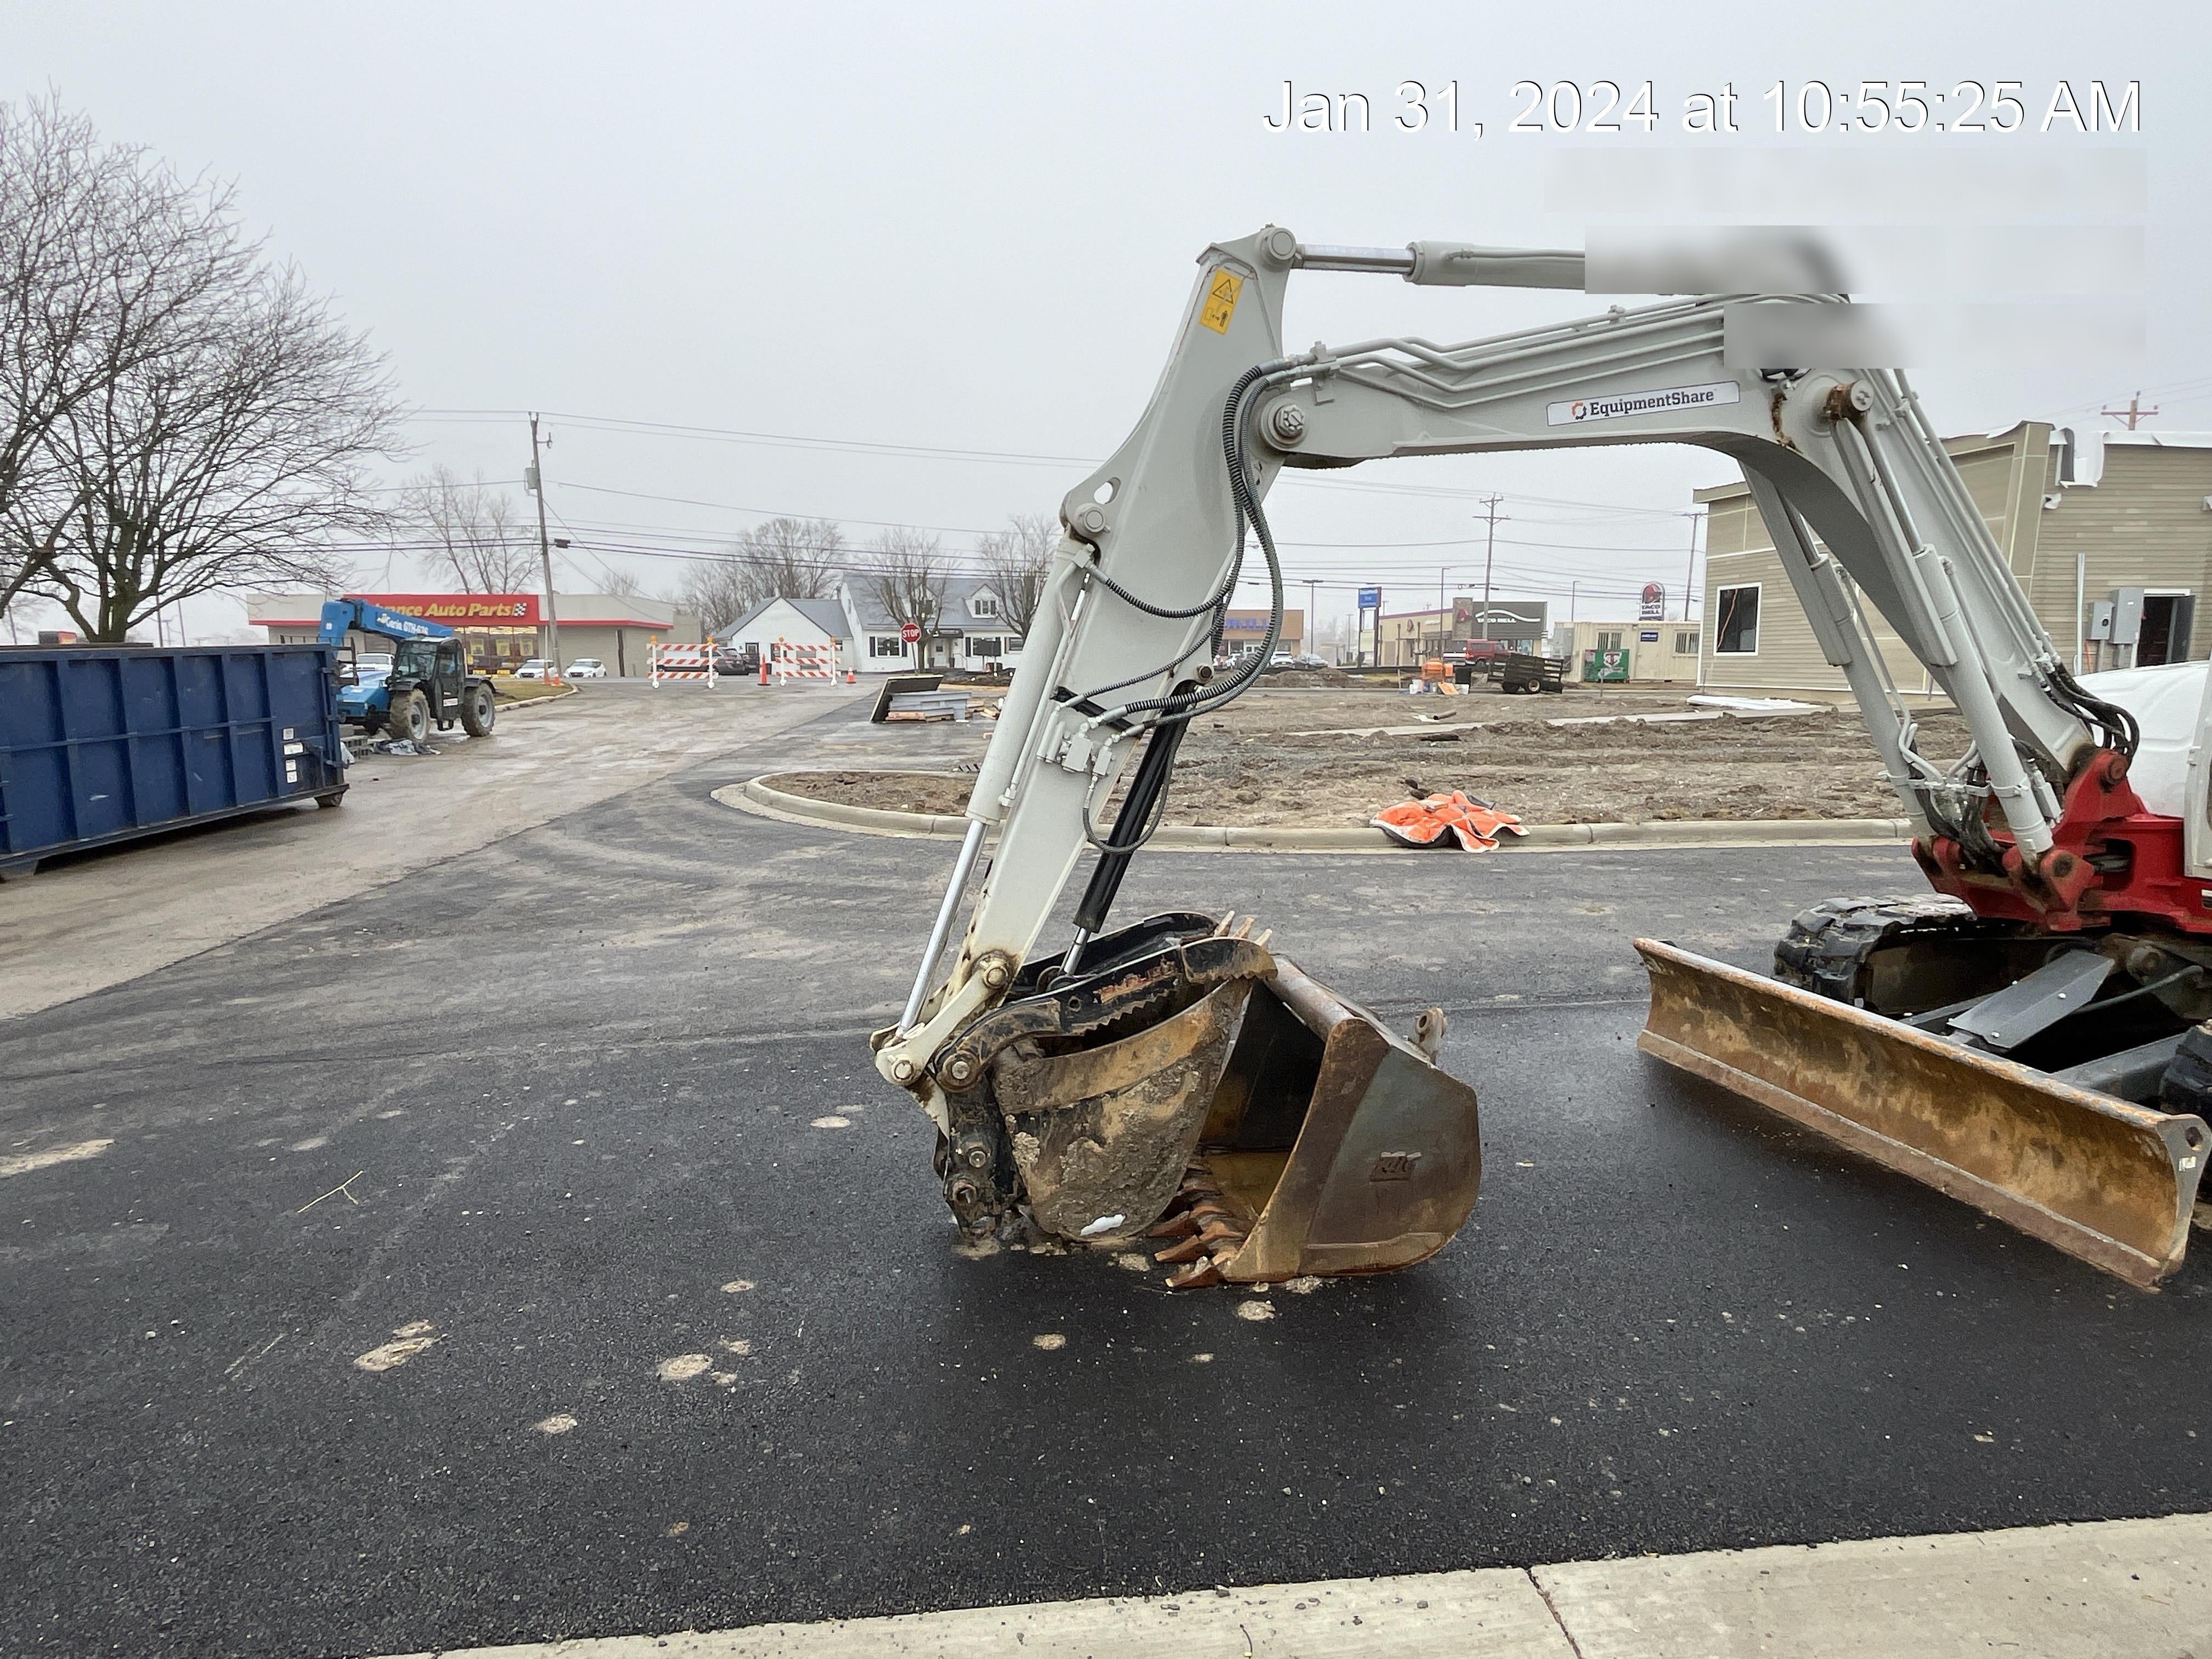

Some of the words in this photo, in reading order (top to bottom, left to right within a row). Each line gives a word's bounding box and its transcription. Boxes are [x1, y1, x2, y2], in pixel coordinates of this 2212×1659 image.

[1590, 391, 1714, 416] EquipmentShare
[425, 603, 466, 617] Auto
[468, 603, 512, 617] Parts
[902, 629, 919, 638] STOP
